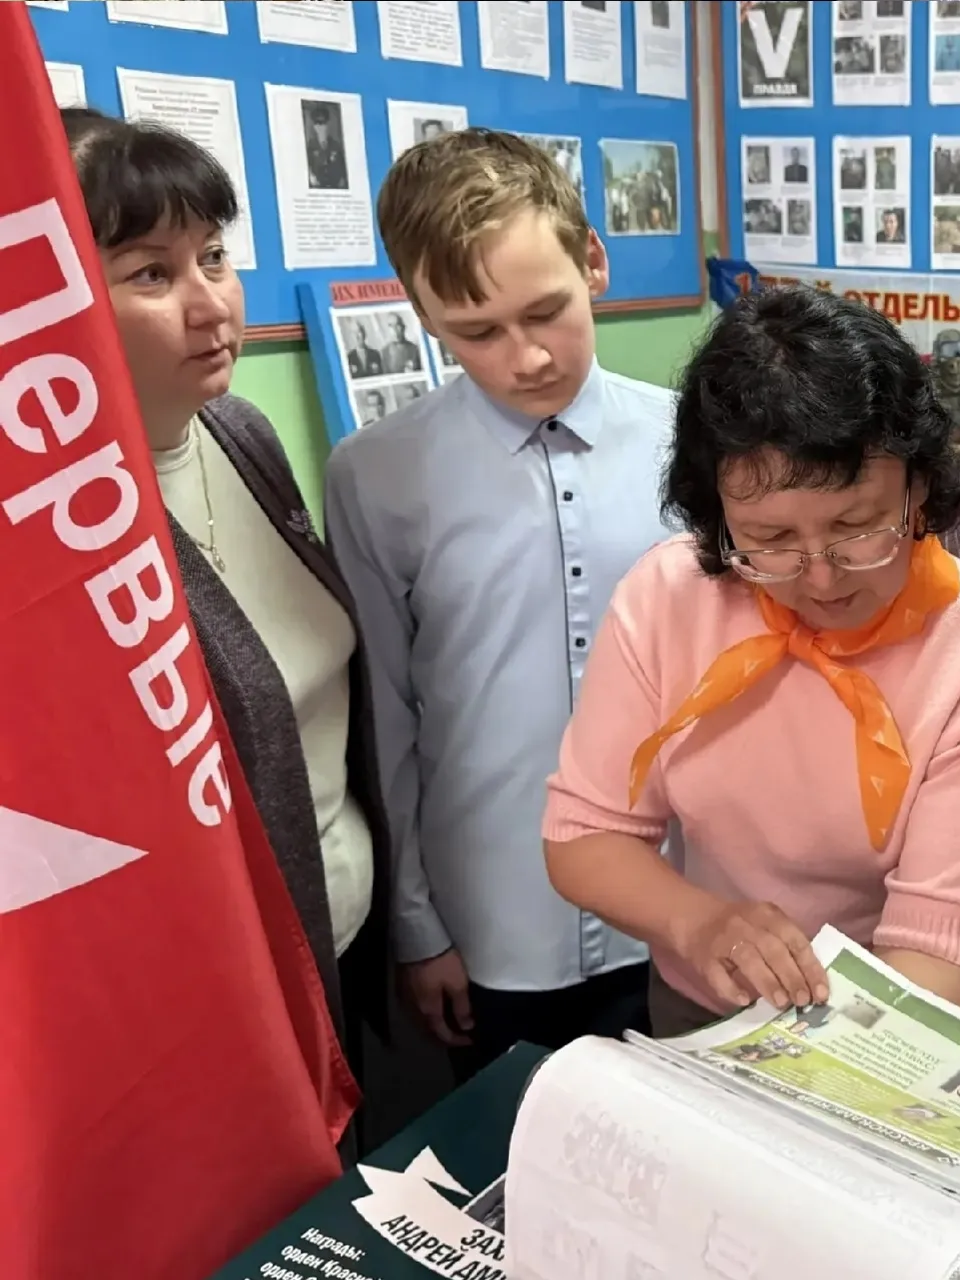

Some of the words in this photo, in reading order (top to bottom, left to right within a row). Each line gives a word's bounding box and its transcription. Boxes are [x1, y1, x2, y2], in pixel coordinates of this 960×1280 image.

[281, 1245, 323, 1268] орден
[301, 1227, 366, 1262] Награды:
[381, 1214, 465, 1269] АНДРЕЙ
